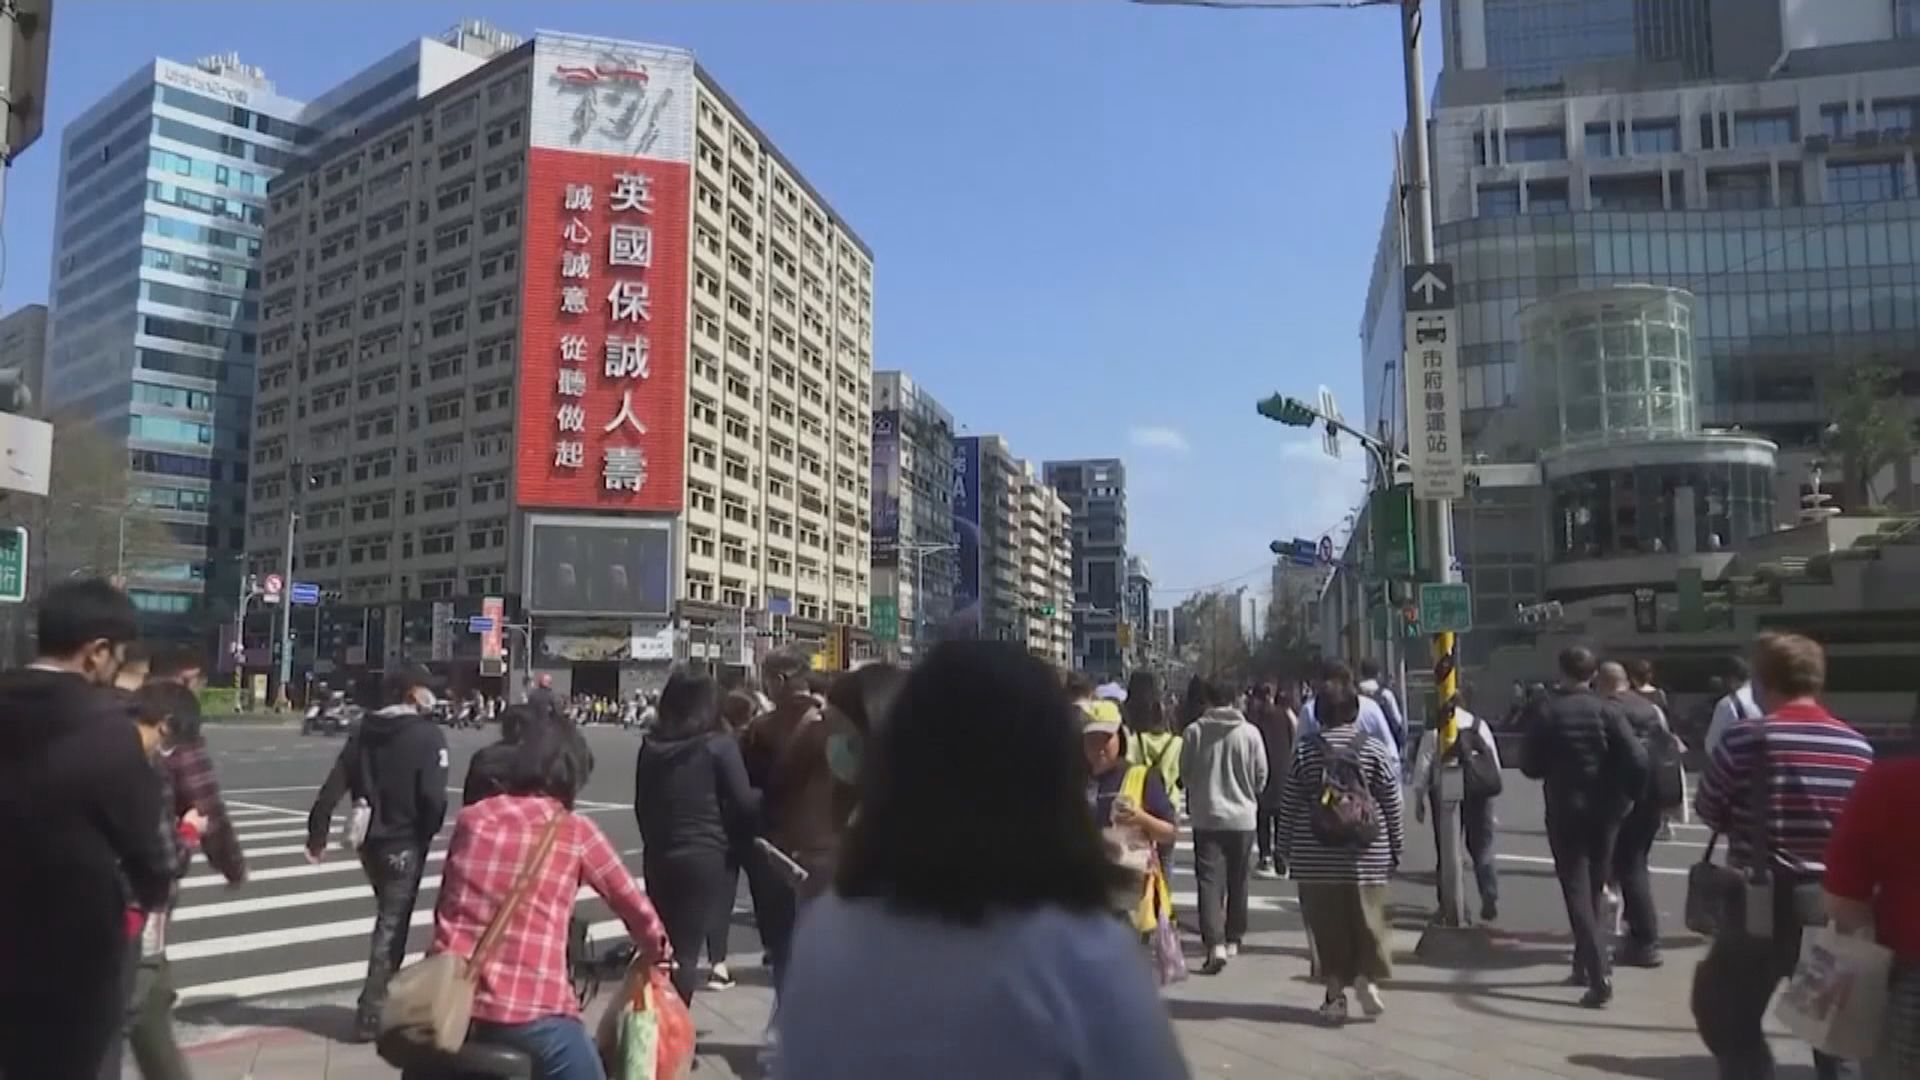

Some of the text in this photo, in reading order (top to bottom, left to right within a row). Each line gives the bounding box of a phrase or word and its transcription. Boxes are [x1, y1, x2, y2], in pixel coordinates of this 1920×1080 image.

[555, 183, 593, 470] 誠心誠意 從聽做起
[603, 171, 654, 492] 英國保誠人壽
